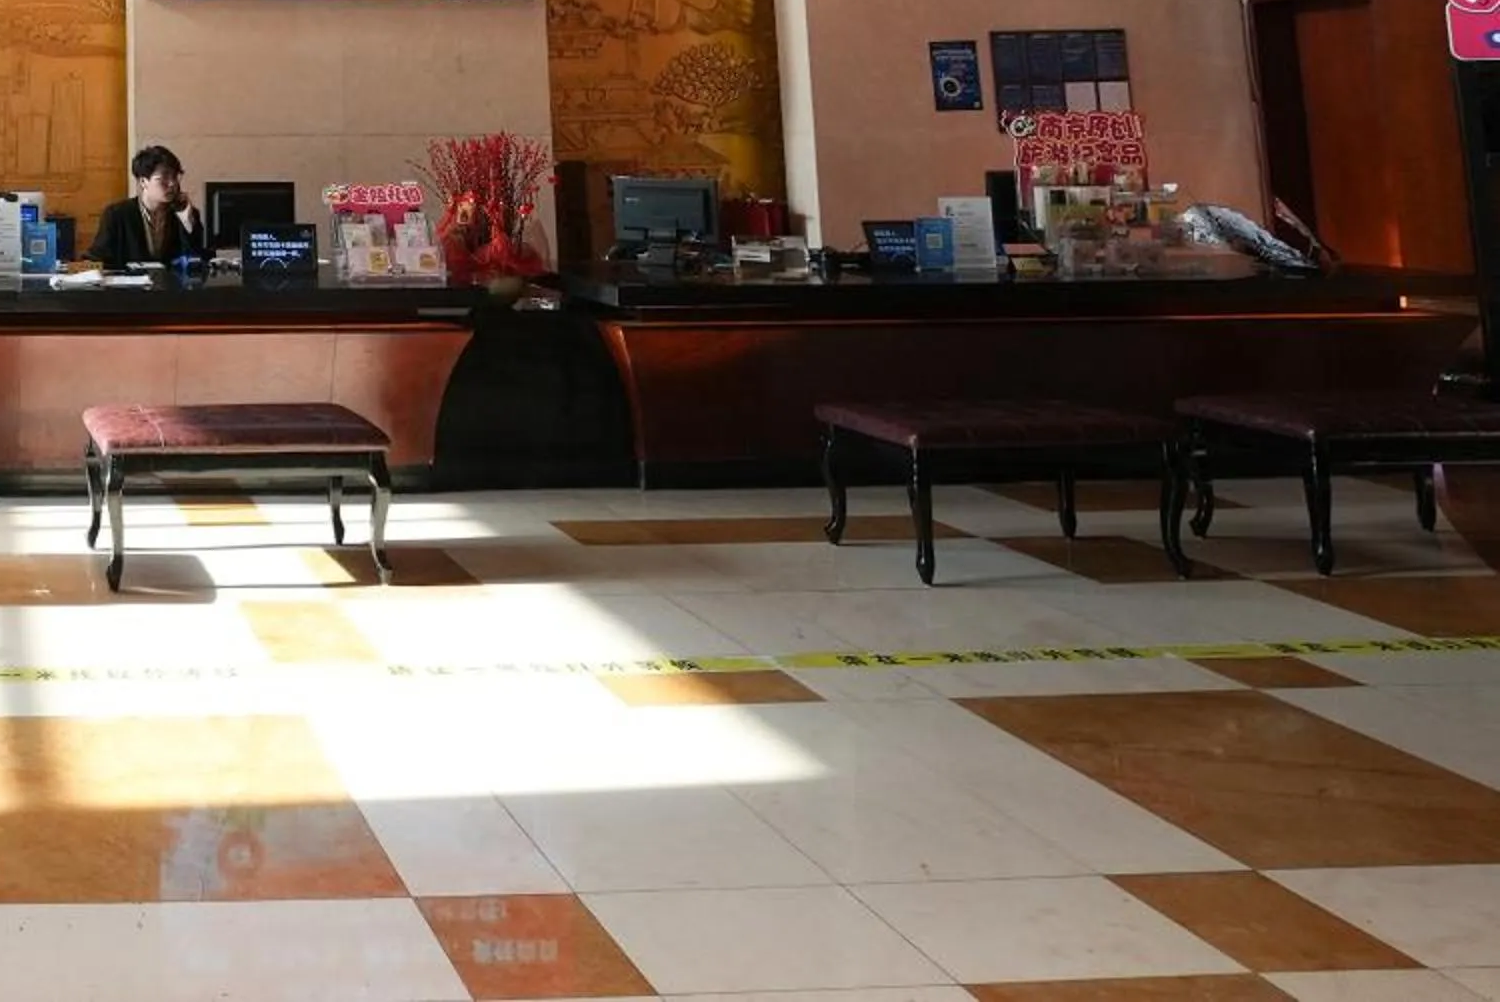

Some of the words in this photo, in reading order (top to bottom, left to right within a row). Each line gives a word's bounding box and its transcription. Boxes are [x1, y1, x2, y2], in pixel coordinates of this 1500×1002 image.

[1039, 113, 1134, 140] 南京原创
[1019, 140, 1143, 166] 旅游纪念品
